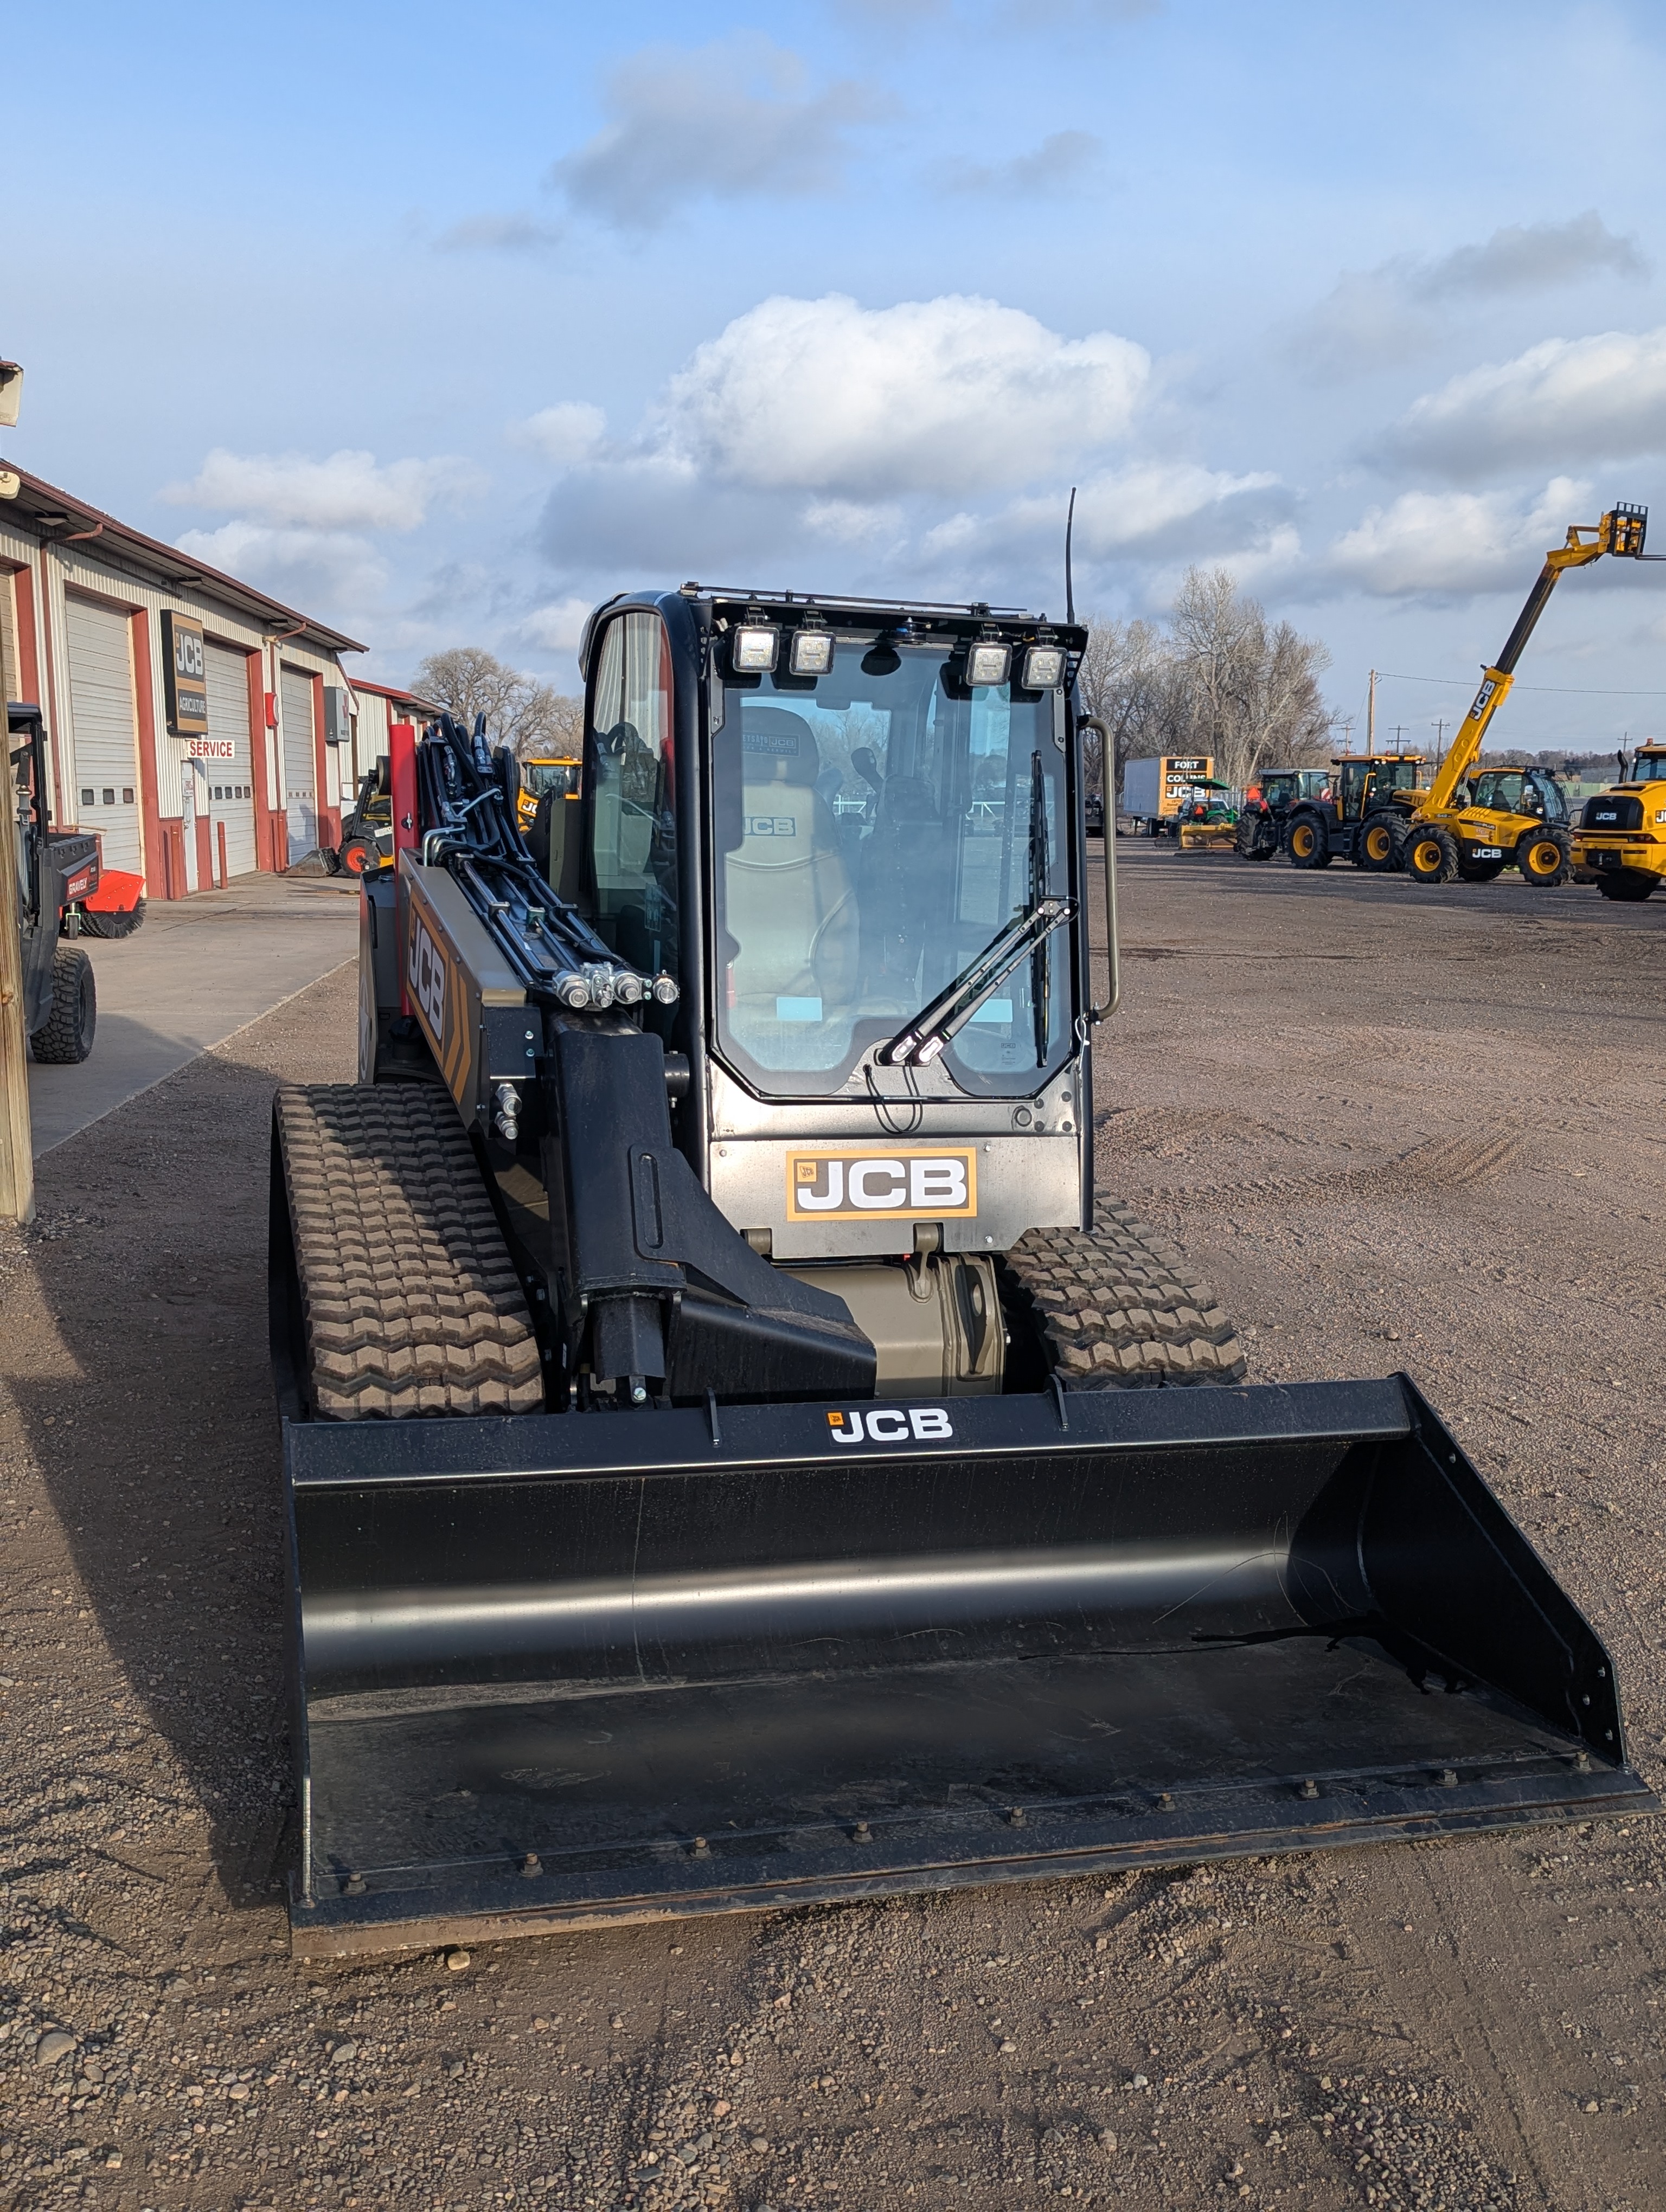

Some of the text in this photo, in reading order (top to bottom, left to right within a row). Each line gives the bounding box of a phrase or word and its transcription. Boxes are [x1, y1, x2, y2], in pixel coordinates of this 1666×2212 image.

[177, 633, 203, 676] JCB
[1473, 680, 1496, 720] JCB
[190, 741, 232, 757] SERVICE
[771, 738, 794, 747] JCB
[1175, 761, 1199, 769] FORT
[1166, 786, 1206, 798] JCB
[1595, 812, 1617, 820] JCB
[1472, 848, 1502, 858] JCB
[409, 917, 445, 1040] JCB
[797, 1159, 967, 1210] JCB
[831, 1408, 953, 1443] JCB
